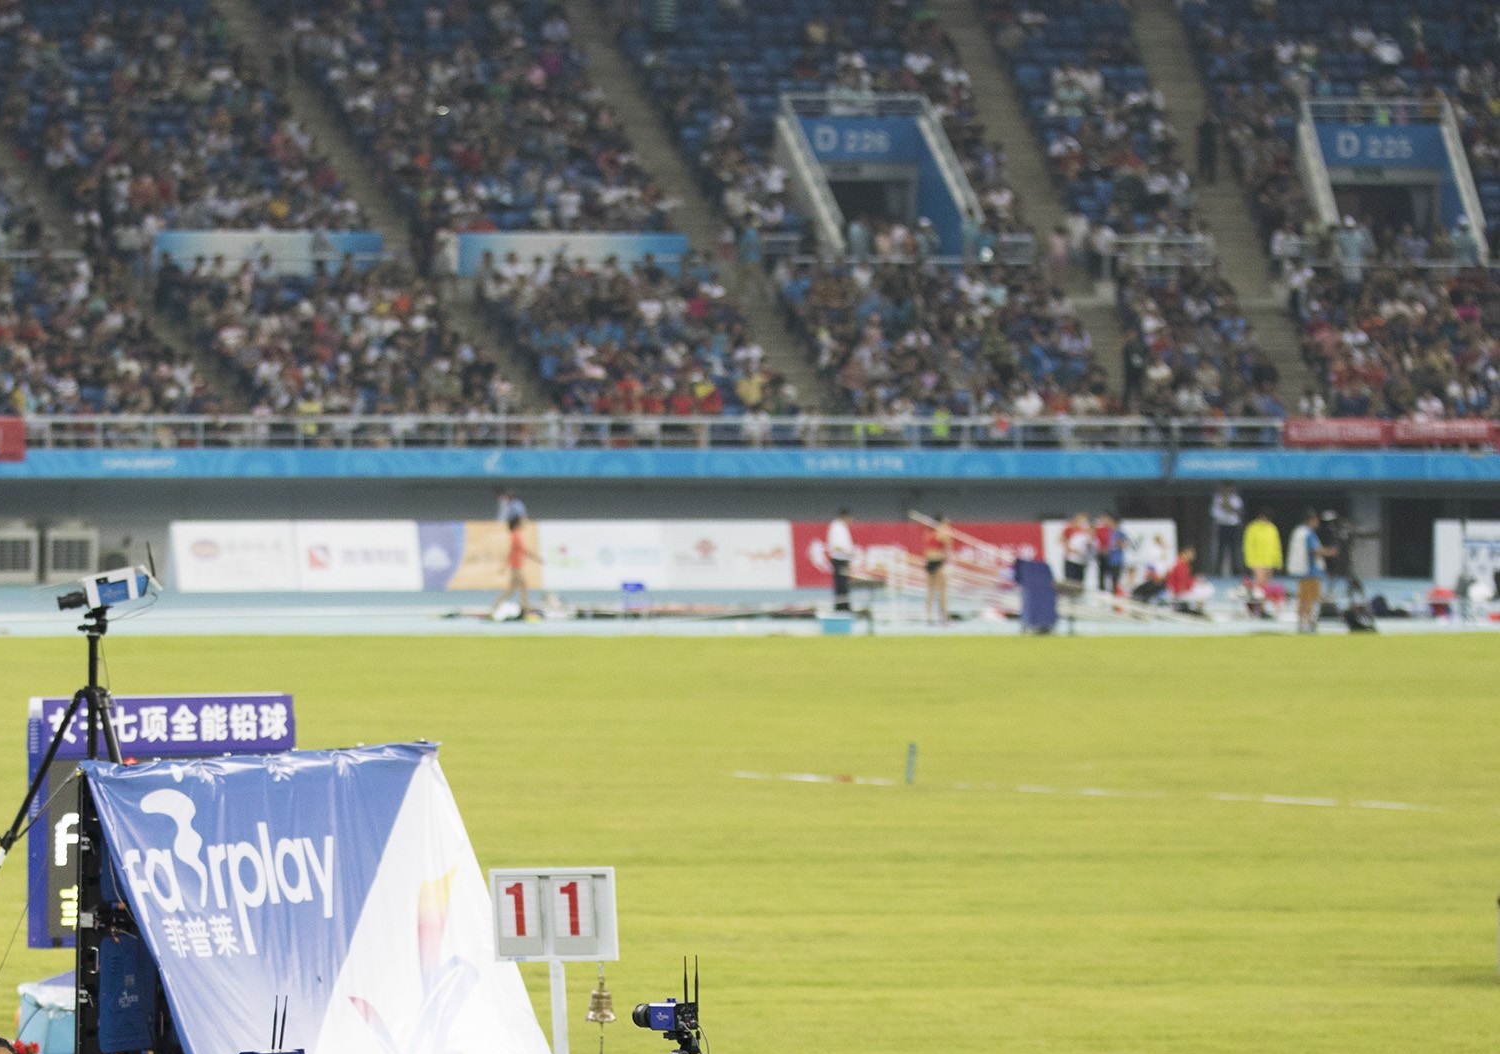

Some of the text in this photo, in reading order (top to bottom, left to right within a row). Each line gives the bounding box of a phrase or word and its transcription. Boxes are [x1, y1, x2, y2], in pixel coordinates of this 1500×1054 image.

[813, 125, 839, 153] D
[1336, 130, 1360, 158] D
[161, 914, 241, 959] 菲普莱
